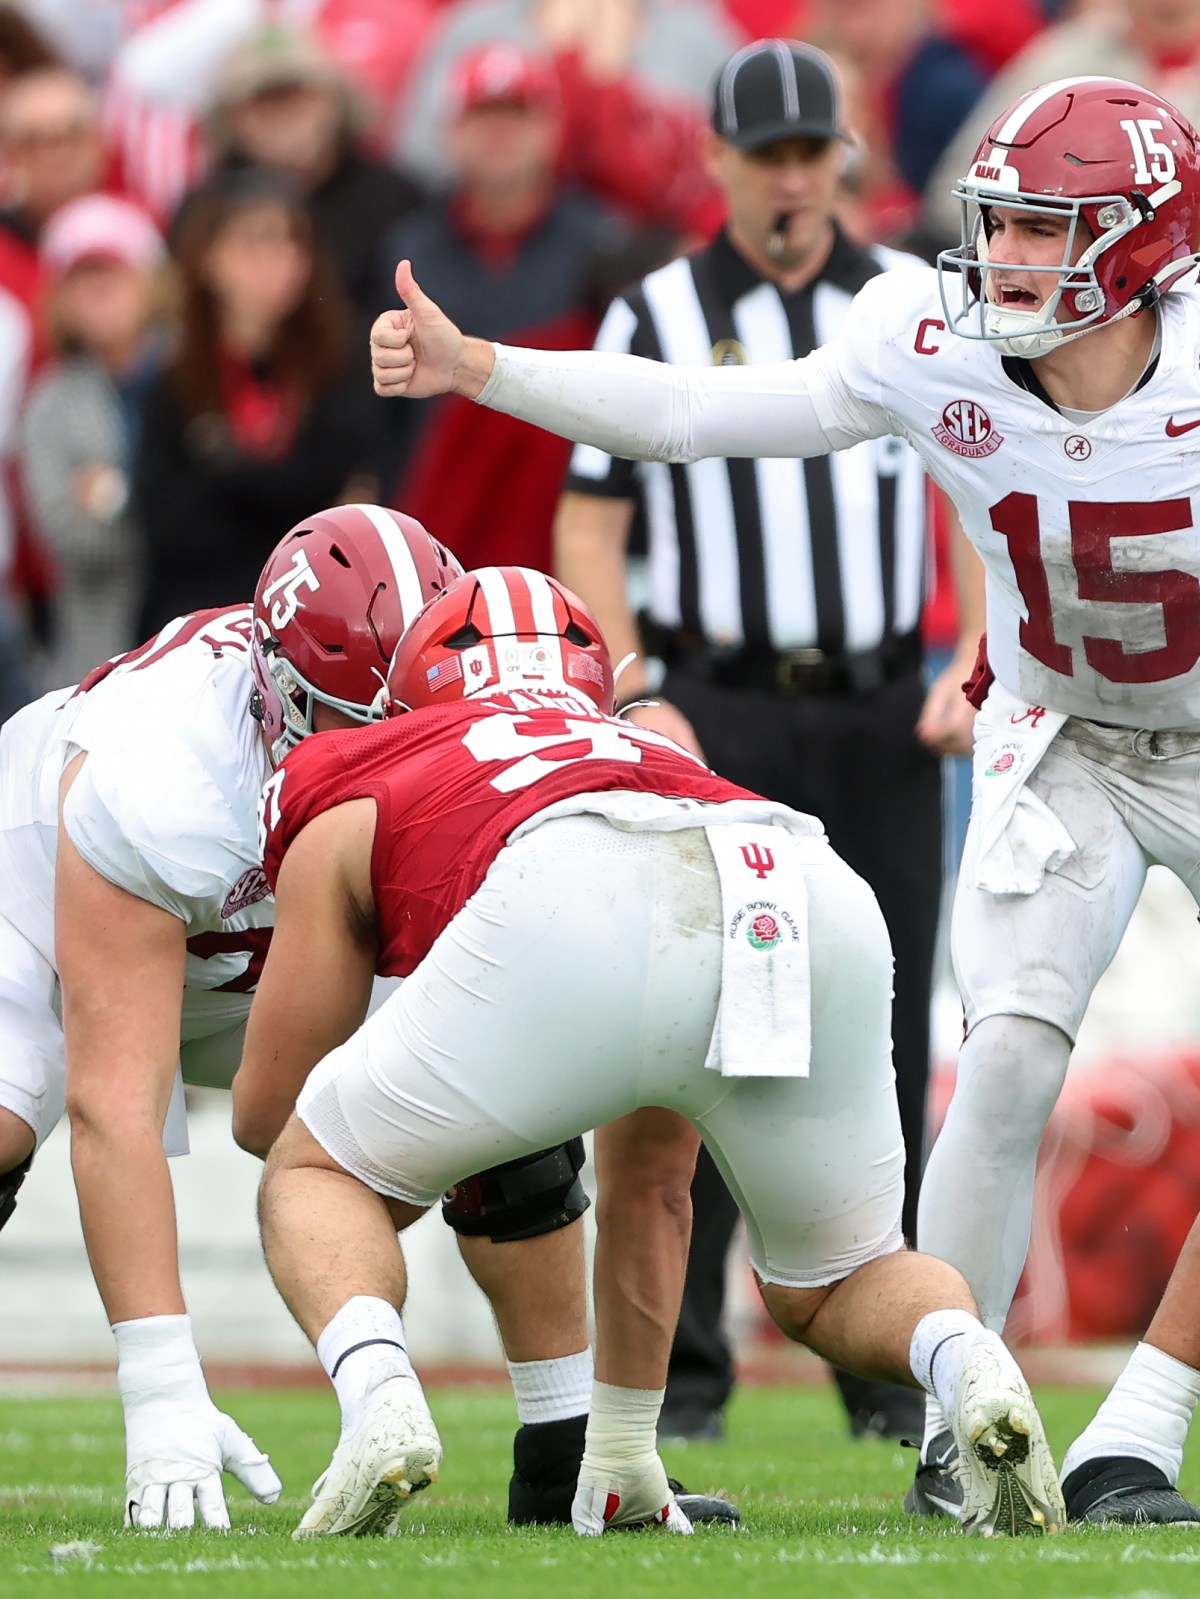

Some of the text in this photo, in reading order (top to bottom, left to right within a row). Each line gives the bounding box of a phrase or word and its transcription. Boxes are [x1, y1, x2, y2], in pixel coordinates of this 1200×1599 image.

[975, 165, 1001, 181] BAMA
[1120, 119, 1178, 186] 15
[914, 318, 946, 355] C
[943, 401, 991, 443] SEC
[941, 435, 993, 456] GRADUATE
[262, 548, 320, 630] 75
[729, 901, 800, 943] ROSE BOWL GAME
